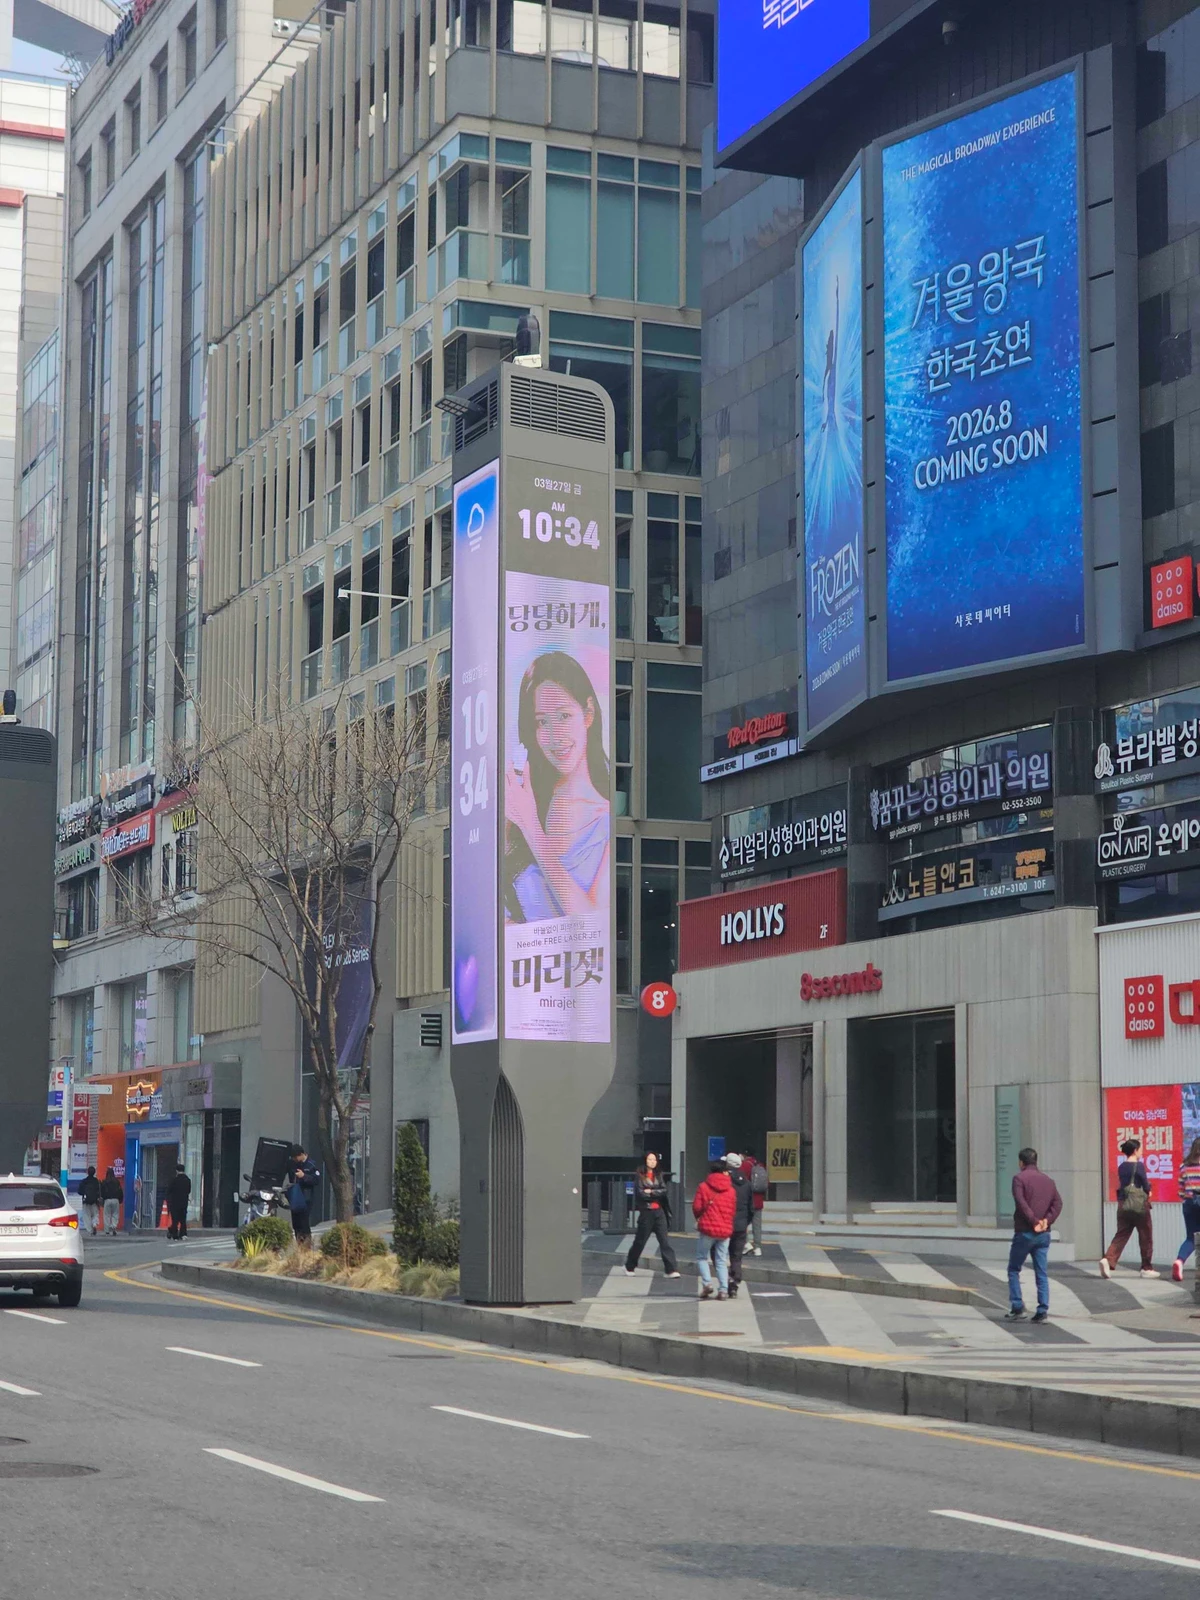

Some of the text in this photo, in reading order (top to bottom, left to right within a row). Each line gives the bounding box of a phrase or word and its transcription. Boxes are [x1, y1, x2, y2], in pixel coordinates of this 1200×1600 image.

[901, 108, 1056, 181] THE MAGICAL BROADWAY EXPERIENCE
[911, 235, 1047, 329] 겨울왕국
[946, 399, 1013, 447] 2026.8
[914, 424, 1049, 490] COMING SOON
[534, 477, 582, 496] 03월27일 금
[551, 501, 565, 513] AM
[518, 508, 600, 550] 10:34
[810, 532, 859, 621] FROZEN
[507, 600, 606, 632] 당당하게,
[954, 602, 1012, 627] 샤롯데씨어터
[1156, 601, 1184, 619] daiso
[461, 689, 488, 750] 10
[727, 712, 787, 749] Red Button
[1116, 718, 1200, 774] 뷰라밸성
[1006, 752, 1050, 790] 의원
[459, 755, 489, 817] 34
[1001, 795, 1042, 811] 02-552-3500
[172, 807, 198, 833] NOLITA
[468, 827, 480, 845] AM
[731, 808, 847, 865] 리얼리성형외과의원
[1101, 834, 1148, 859] ON AIR
[908, 857, 974, 899] 노블앤코
[1102, 862, 1147, 878] PLASTIC SURGERY
[989, 880, 1028, 896] 6247-3100
[1033, 879, 1046, 890] 10F
[720, 902, 784, 945] HOLLYS
[819, 924, 828, 939] 2F
[516, 930, 602, 949] Needle FREE LASER JET
[351, 946, 370, 963] Series
[801, 962, 883, 1002] 8seconds
[539, 996, 577, 1011] mirajet
[1128, 1018, 1155, 1032] daiso
[1123, 1110, 1145, 1121] 다이소
[1146, 1125, 1173, 1151] 최대
[1146, 1153, 1174, 1180] 오픈
[15, 1226, 34, 1234] 3604
